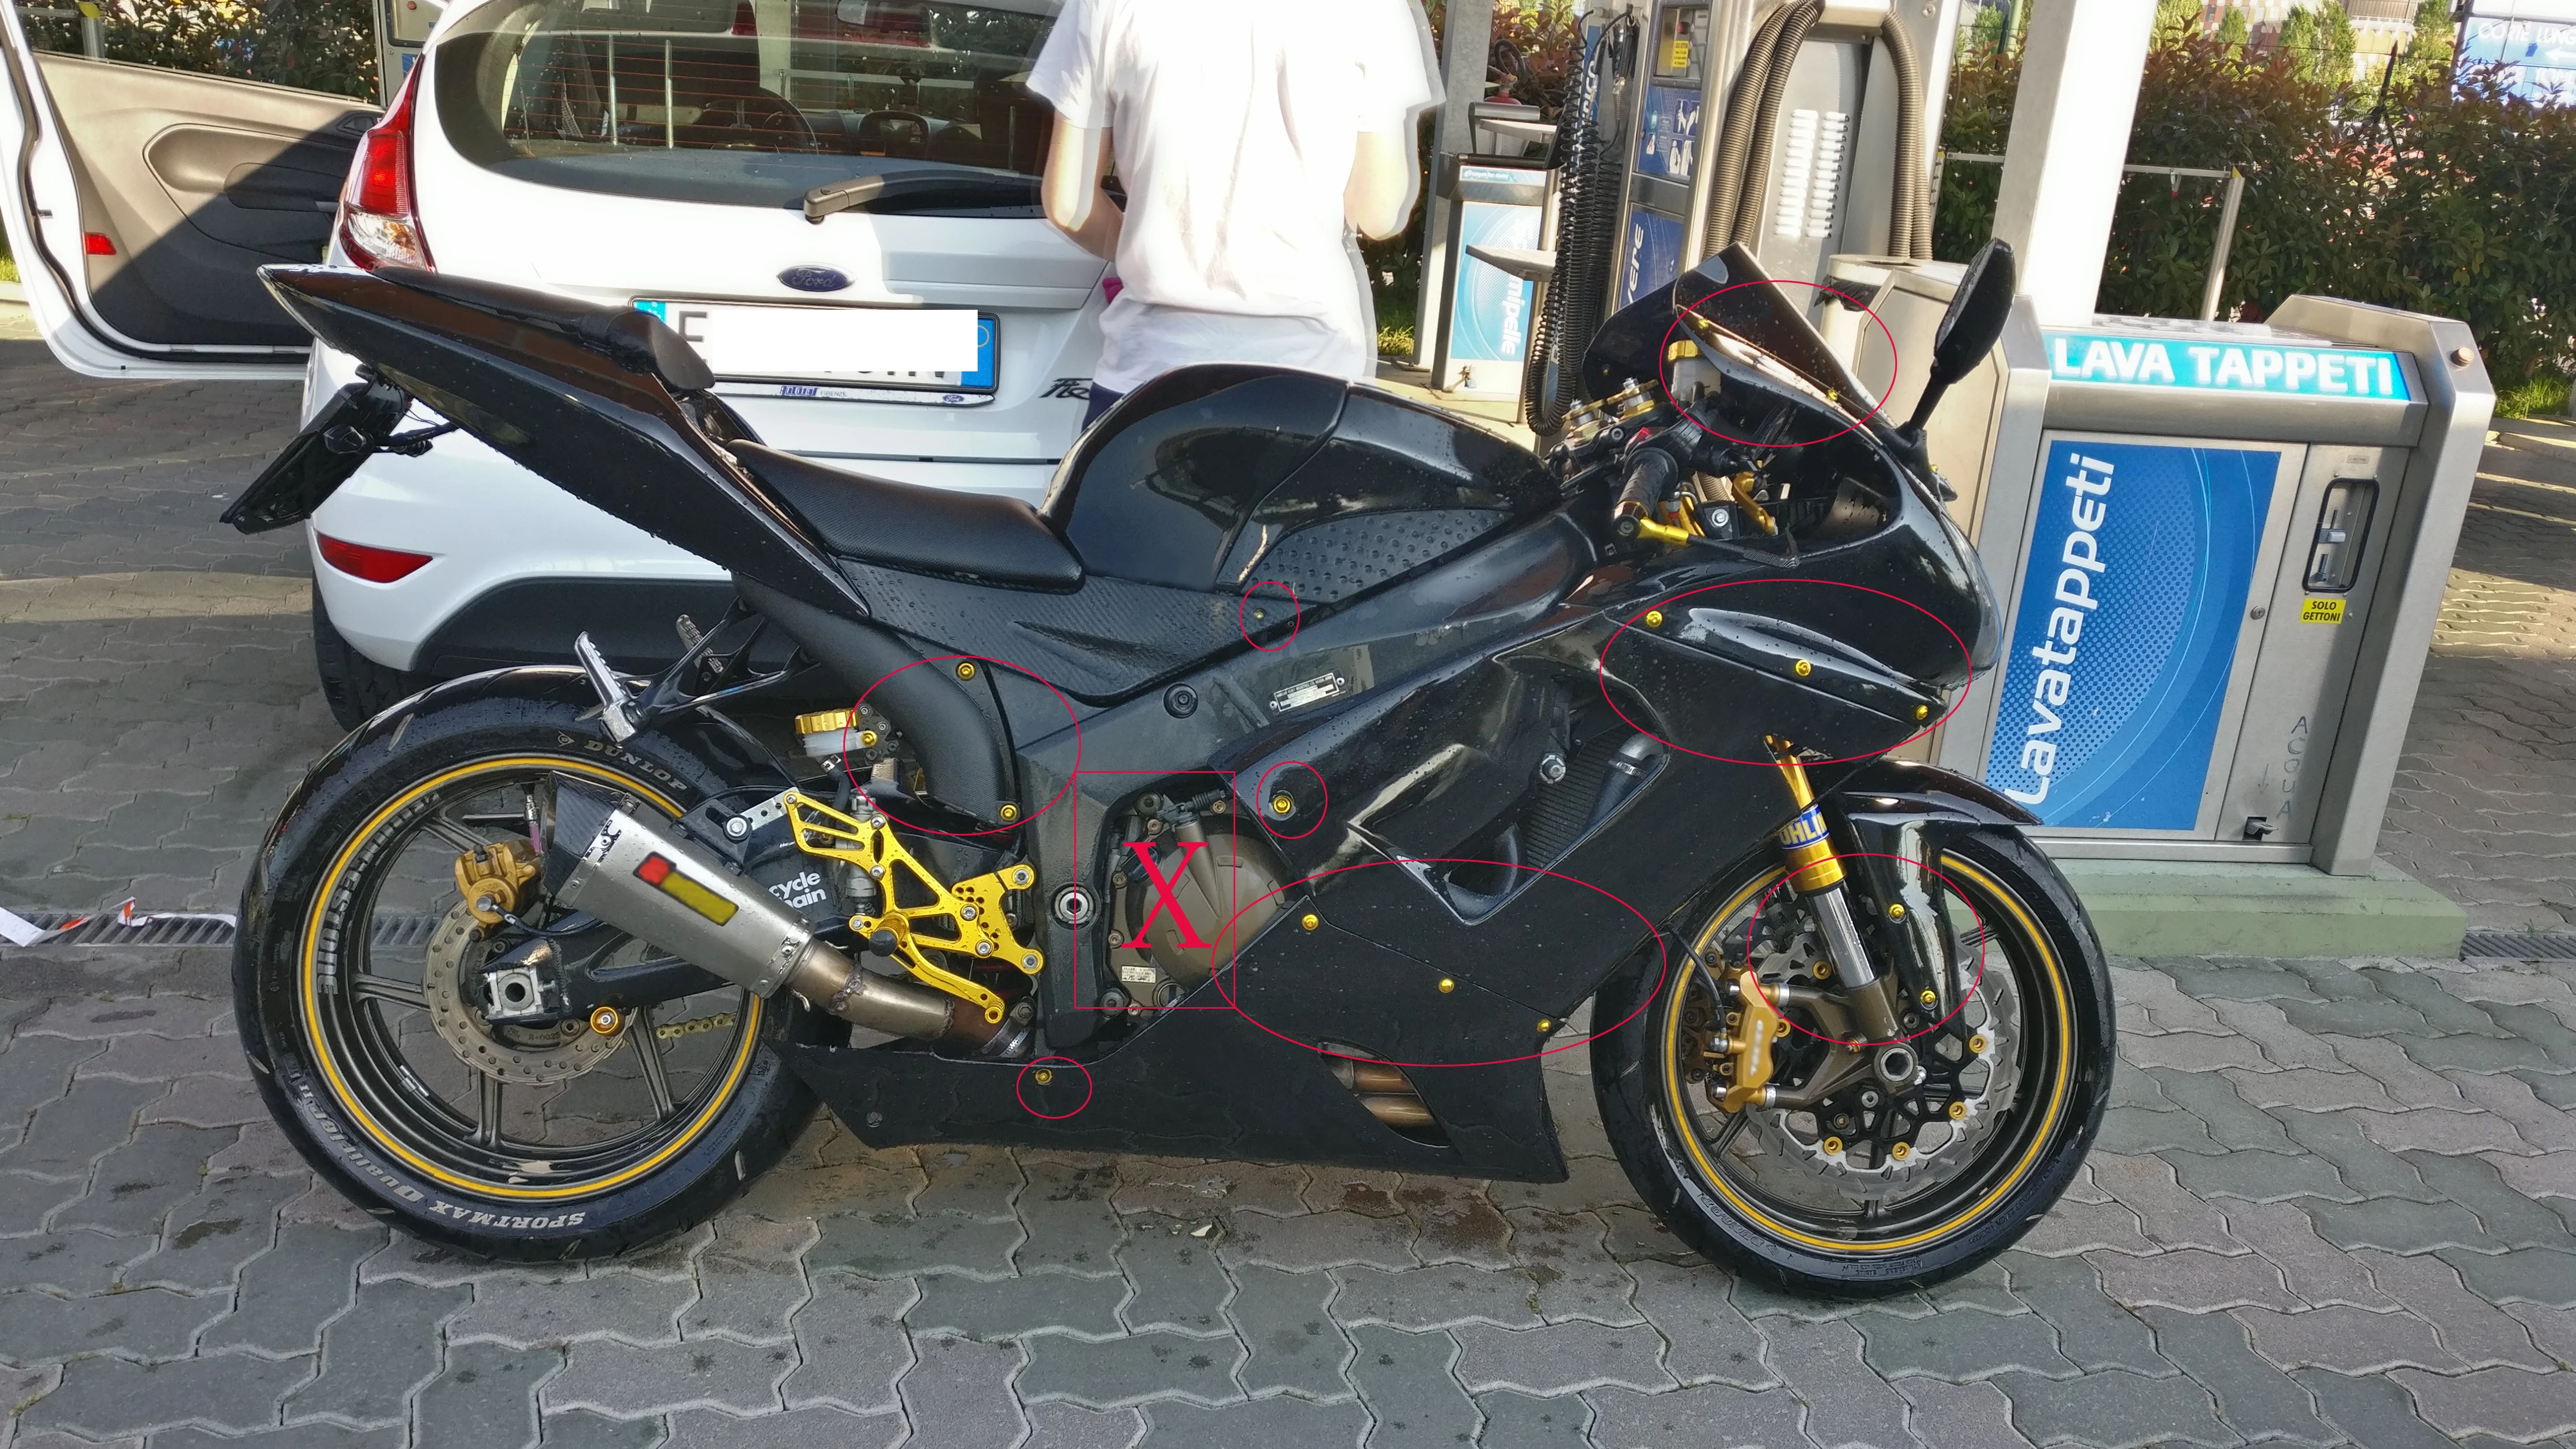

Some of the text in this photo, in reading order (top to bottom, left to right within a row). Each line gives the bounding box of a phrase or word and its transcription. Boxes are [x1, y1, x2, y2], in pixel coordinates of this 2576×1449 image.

[791, 268, 837, 288] Ford
[2054, 337, 2393, 395] LAVA TAPPETI
[2303, 611, 2341, 622] GETTONI
[2311, 601, 2337, 610] SOLO
[2005, 452, 2116, 805] Lavatappeti
[583, 739, 687, 791] DUNLOP
[429, 1199, 586, 1229] SPORTMAX
